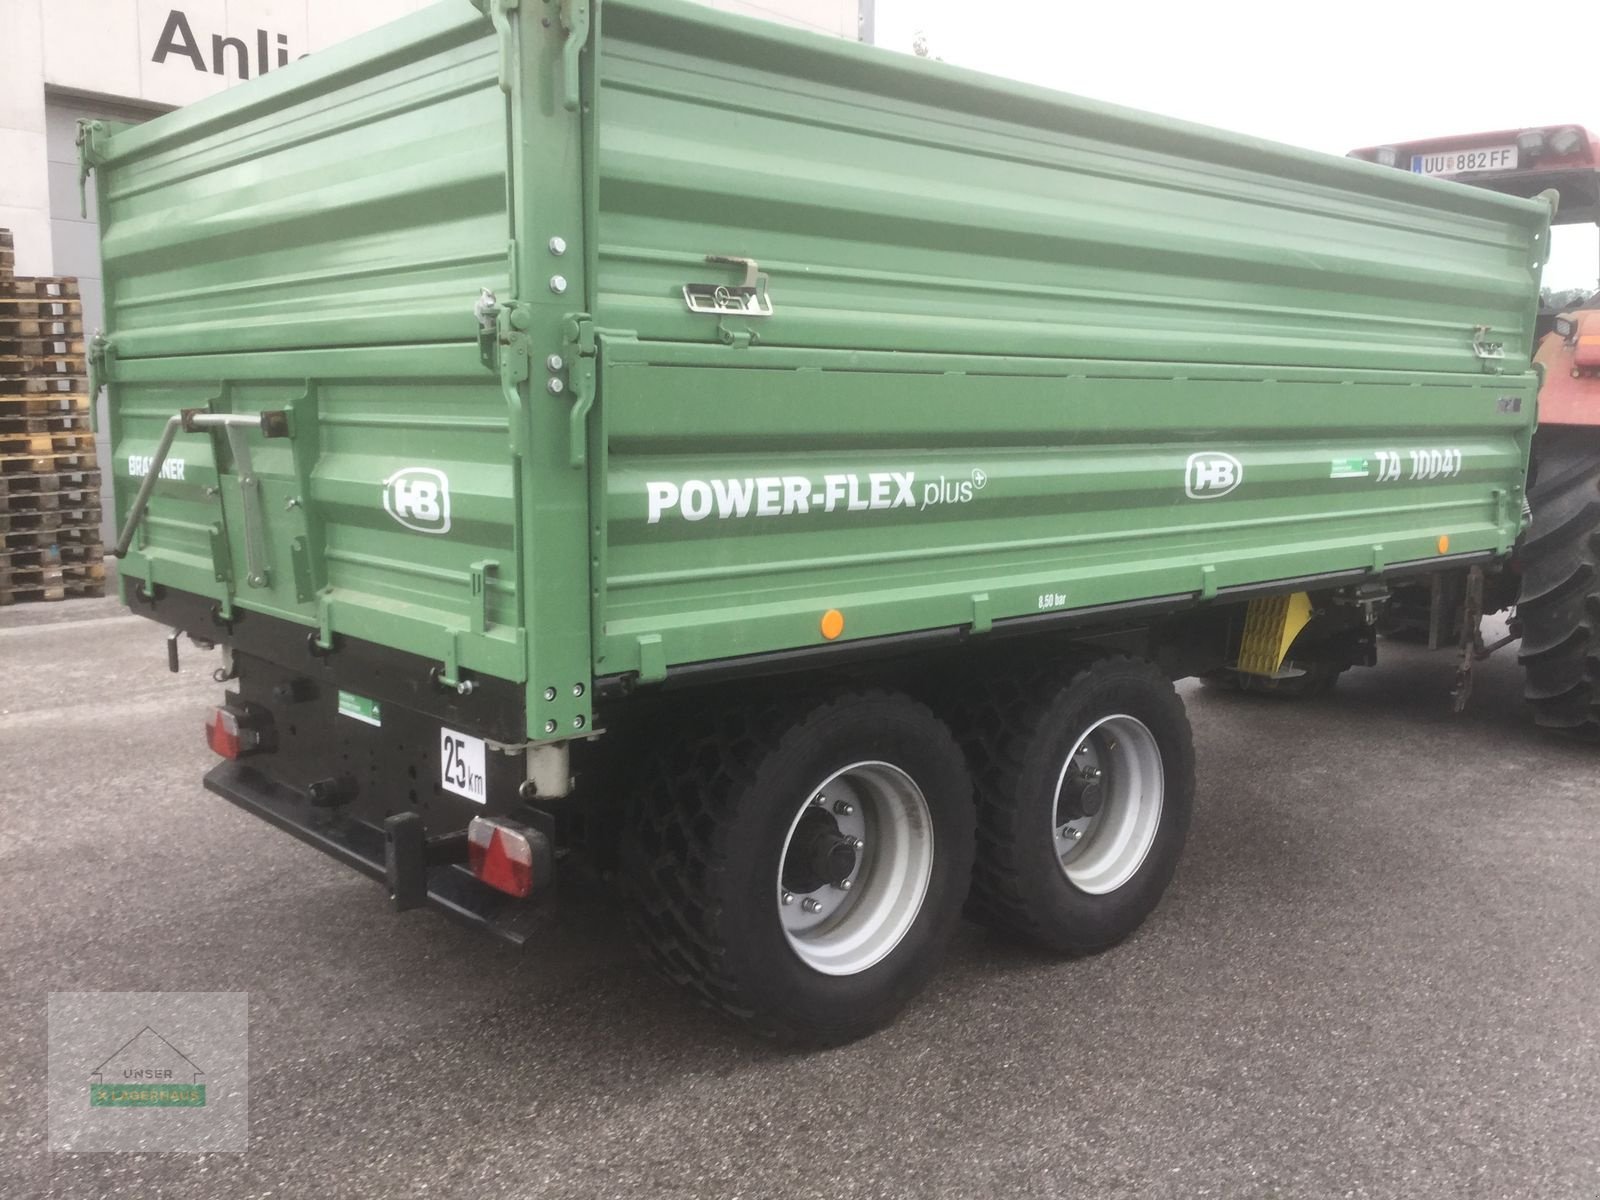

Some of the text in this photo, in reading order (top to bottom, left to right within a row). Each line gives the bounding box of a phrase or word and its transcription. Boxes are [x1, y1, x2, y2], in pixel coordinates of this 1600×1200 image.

[151, 9, 311, 80] Anli
[128, 455, 185, 480] BRANER
[1374, 451, 1400, 482] TA
[646, 471, 917, 523] POWER-FLEX
[444, 735, 483, 795] 25 km
